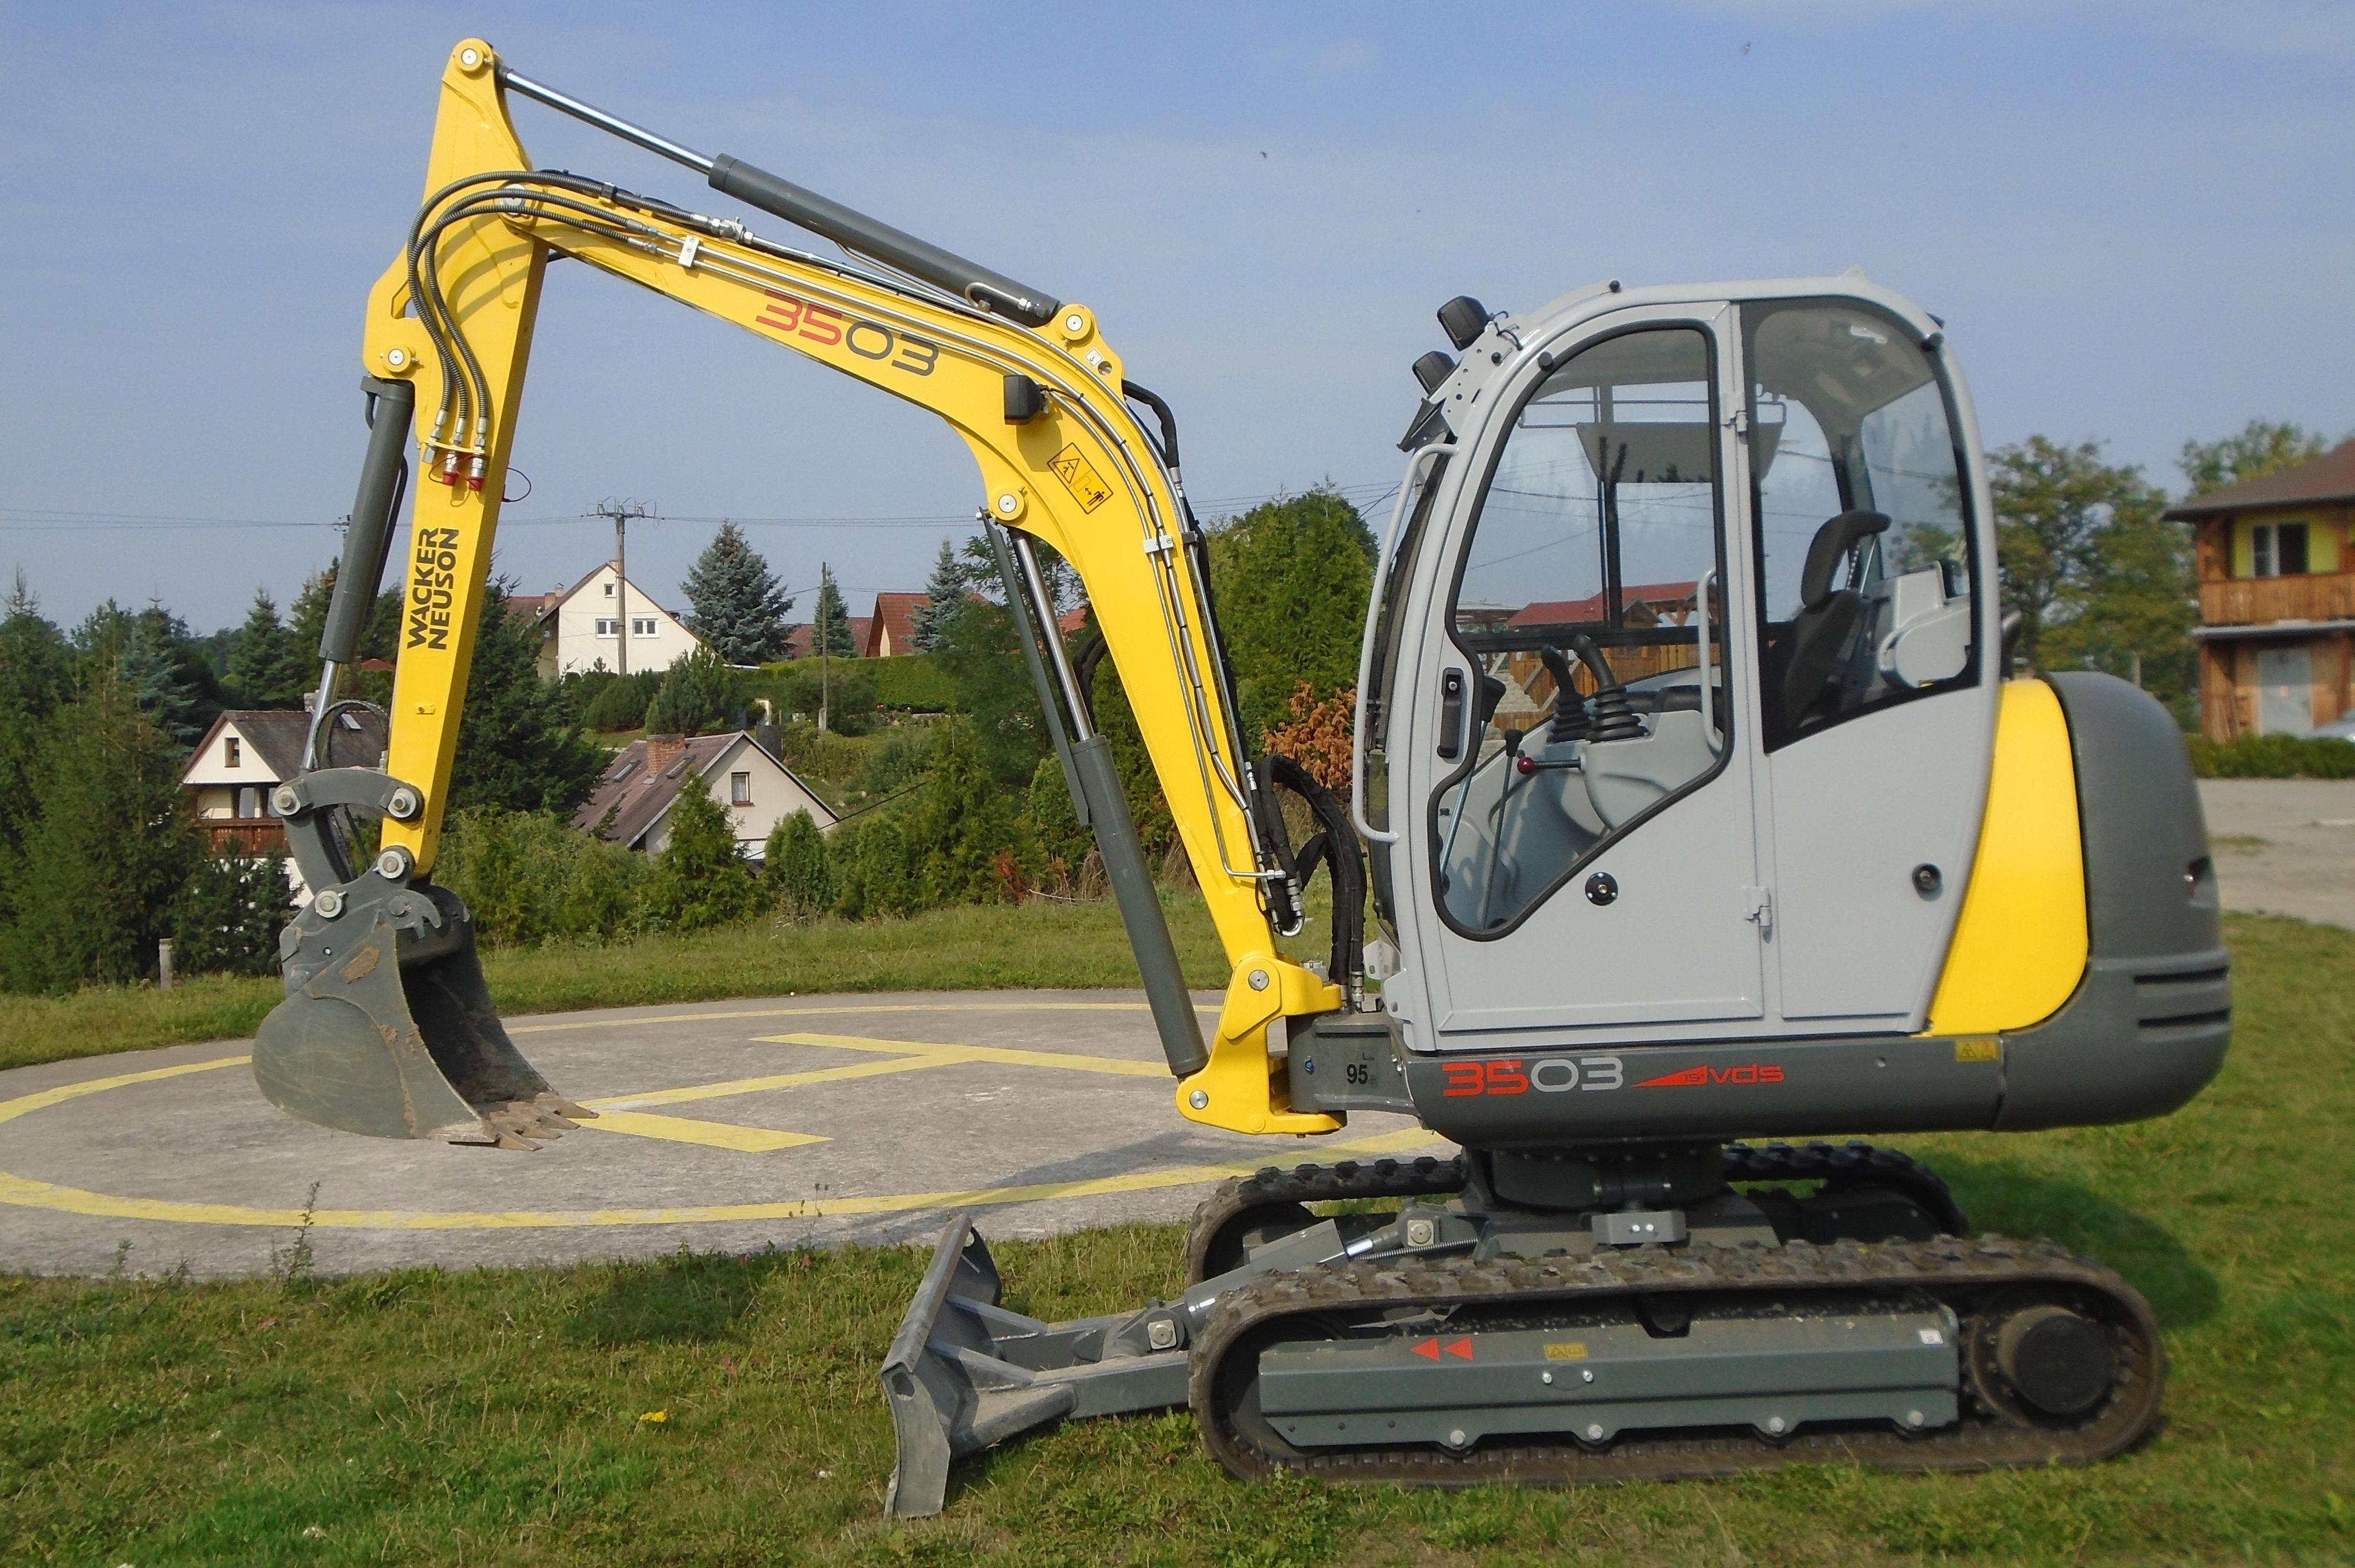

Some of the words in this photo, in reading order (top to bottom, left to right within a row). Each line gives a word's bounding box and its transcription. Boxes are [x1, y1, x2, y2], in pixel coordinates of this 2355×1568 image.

[755, 290, 939, 377] 3503
[406, 527, 439, 649] WACKER
[427, 528, 460, 650] NEUSON
[1346, 1064, 1368, 1084] 95
[1442, 1057, 1624, 1097] 3503
[1709, 1062, 1786, 1084] vds
